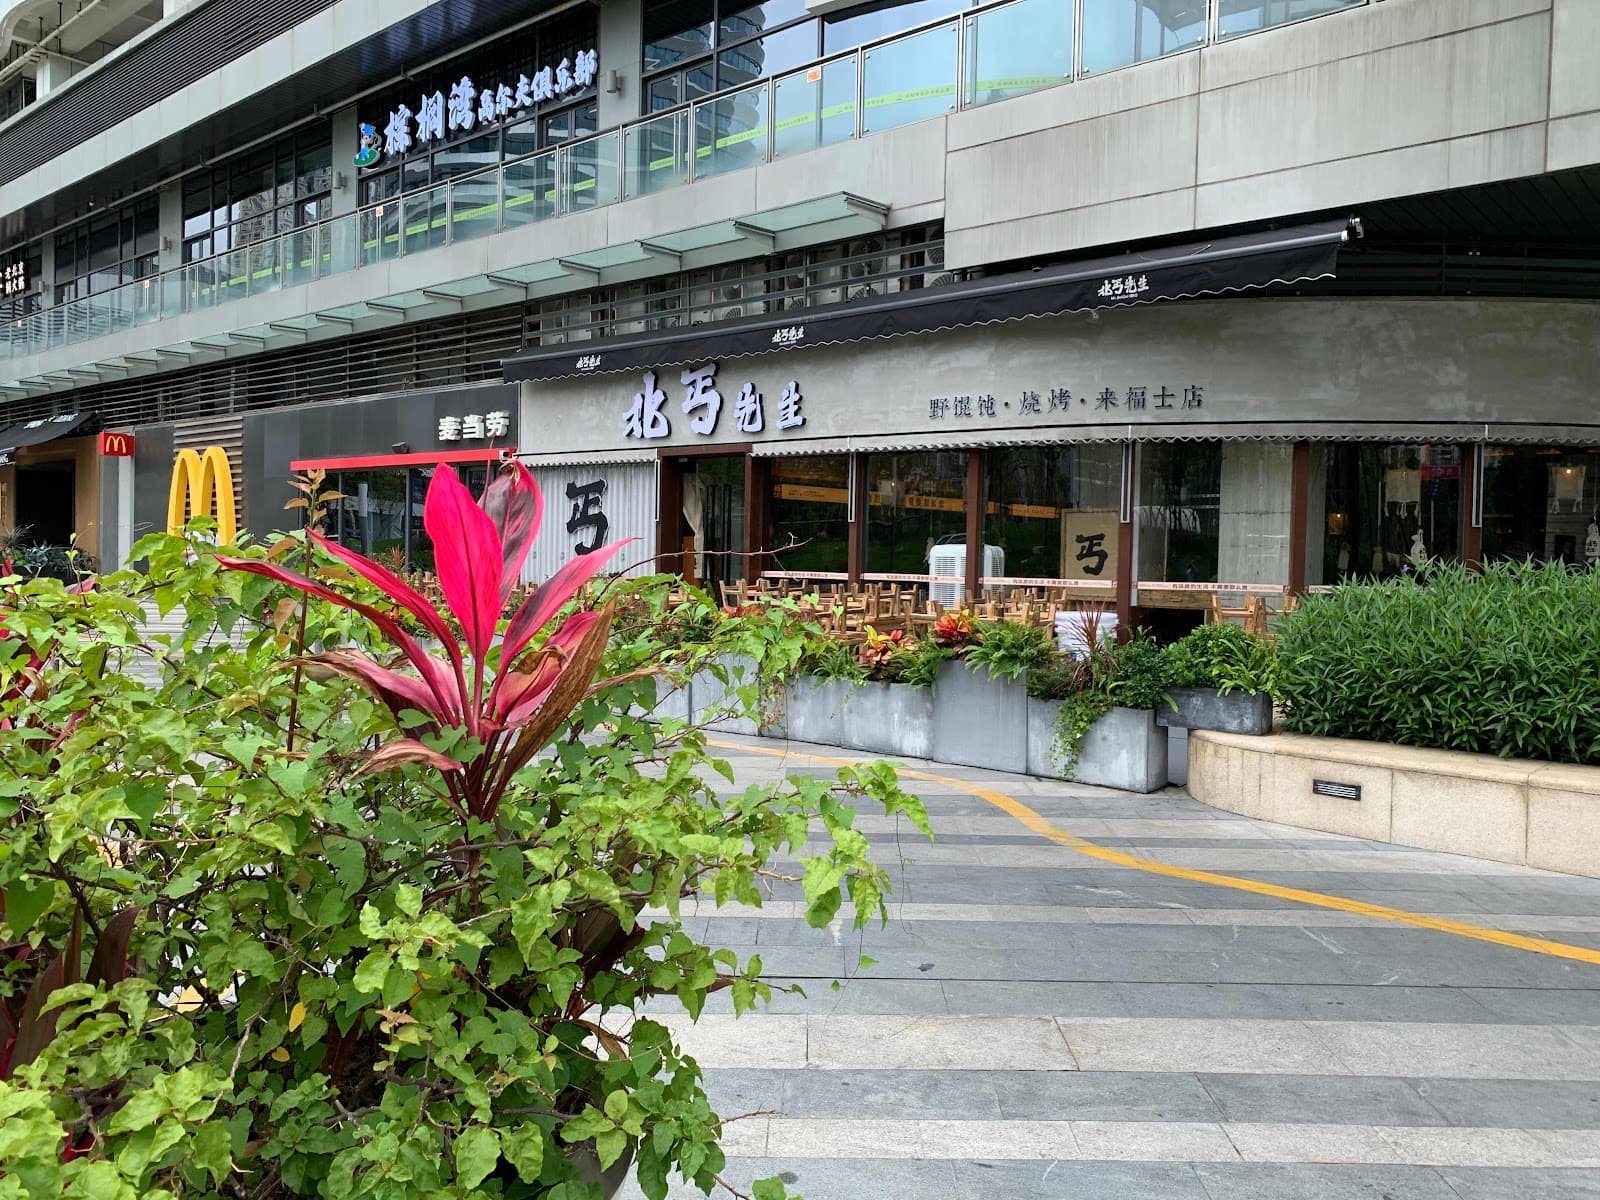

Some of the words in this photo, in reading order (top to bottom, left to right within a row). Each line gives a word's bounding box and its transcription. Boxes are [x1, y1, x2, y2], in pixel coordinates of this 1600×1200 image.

[384, 48, 598, 156] 棕榈湾高尔夫俱乐部
[438, 410, 510, 441] 麦当劳
